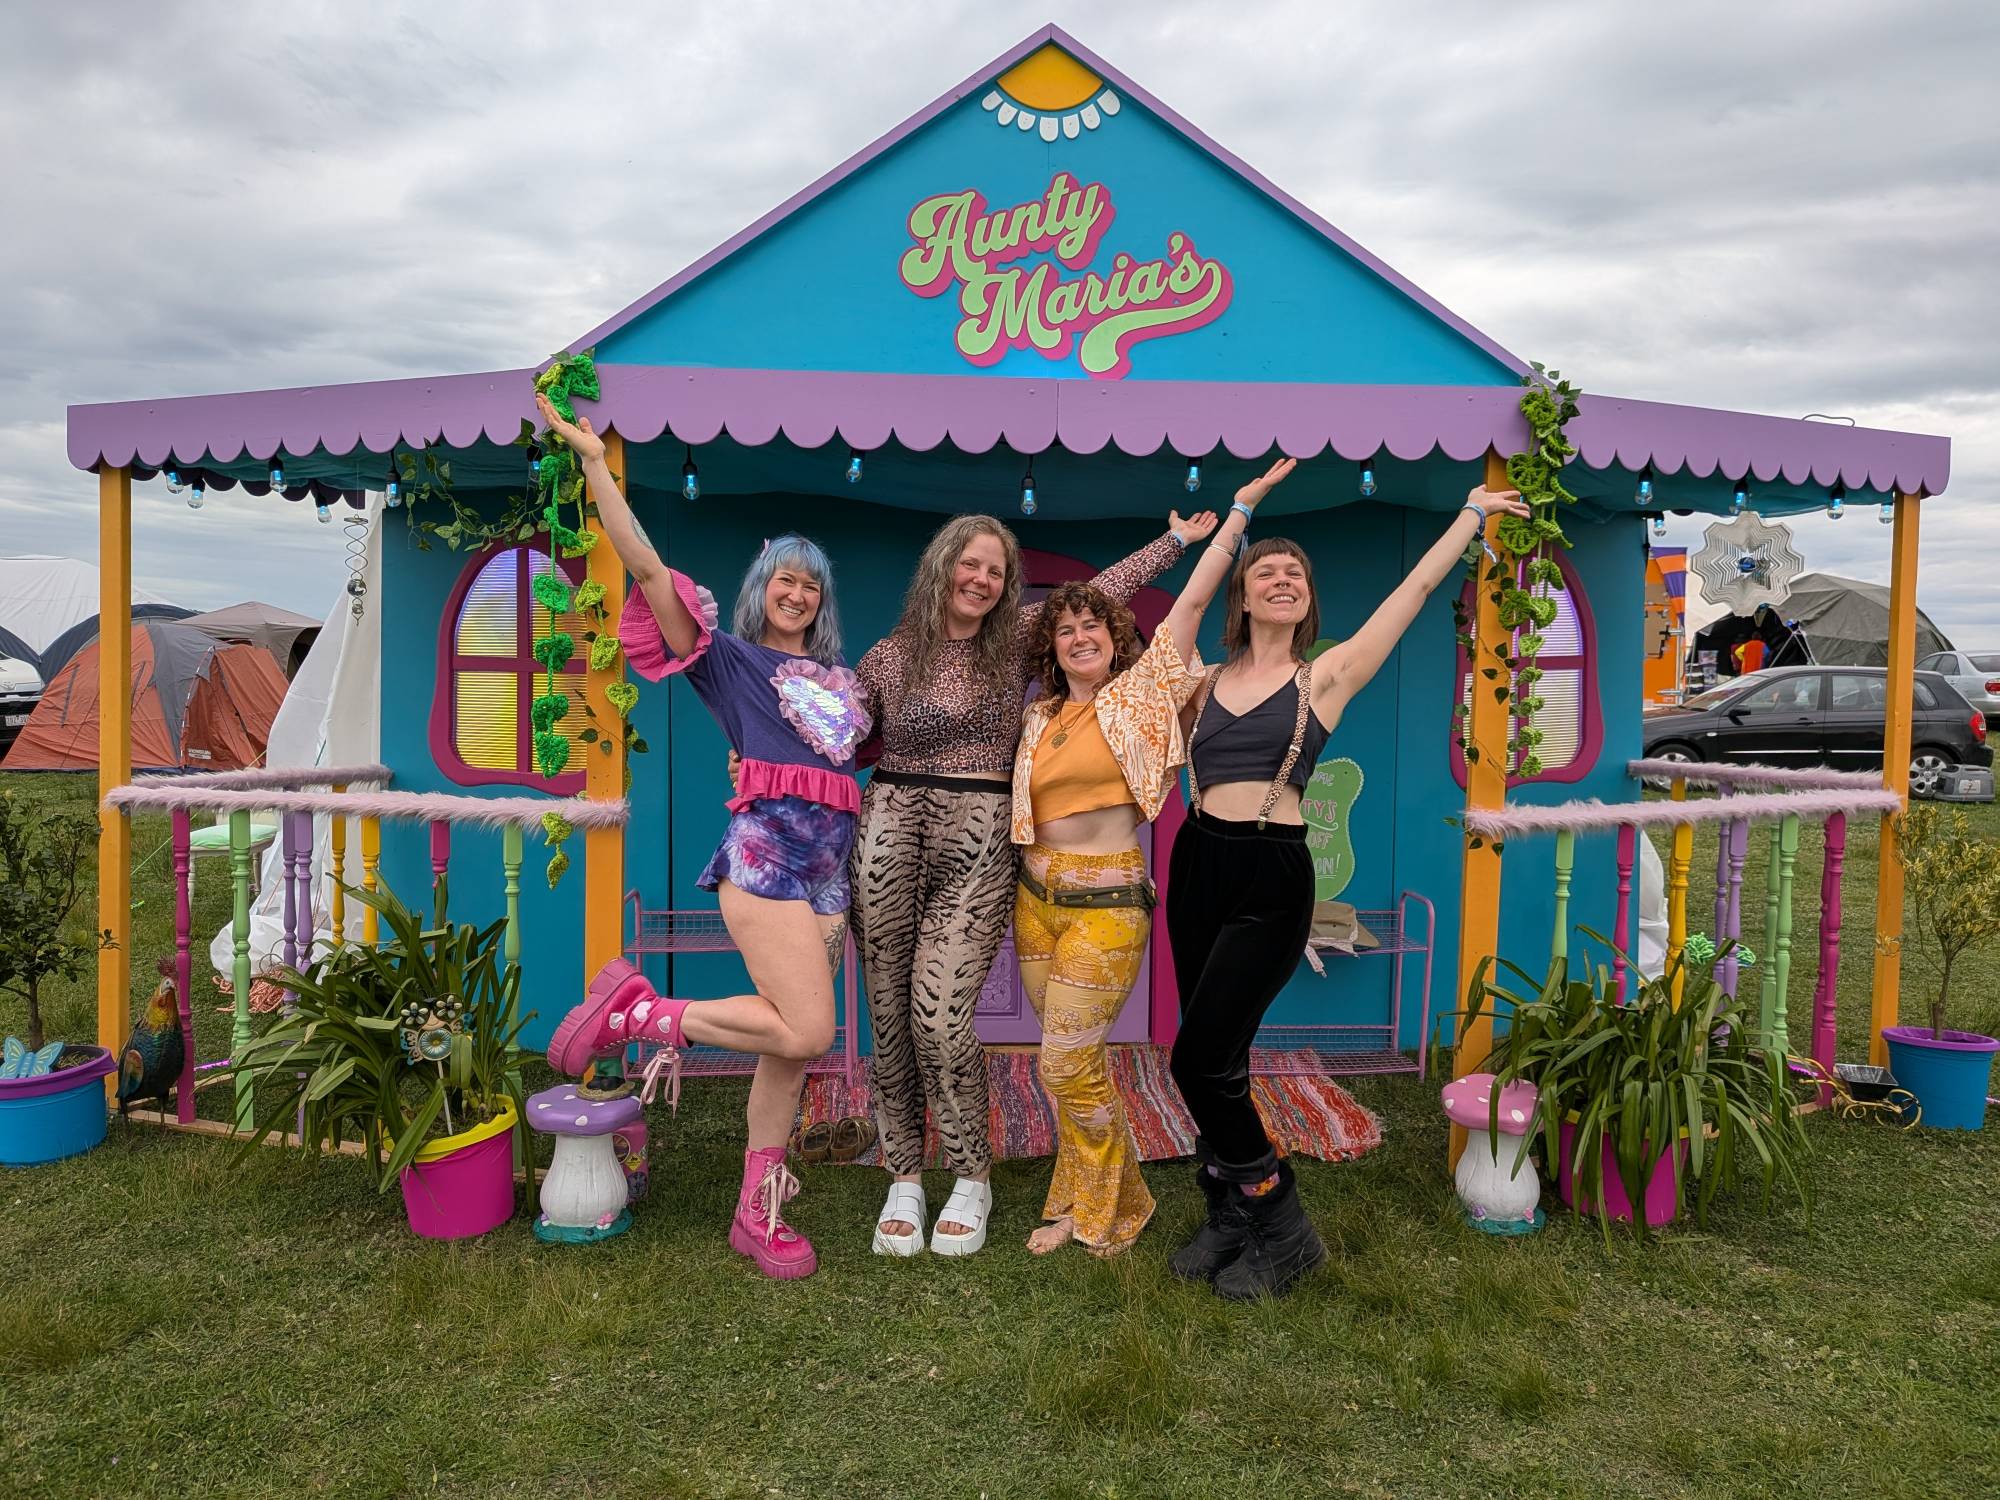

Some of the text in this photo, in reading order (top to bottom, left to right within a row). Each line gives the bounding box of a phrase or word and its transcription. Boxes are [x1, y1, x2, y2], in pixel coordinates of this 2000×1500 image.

[900, 173, 1111, 290] Aunty
[956, 233, 1226, 376] Maria's
[1303, 799, 1337, 823] TYS
[1311, 772, 1335, 787] OME
